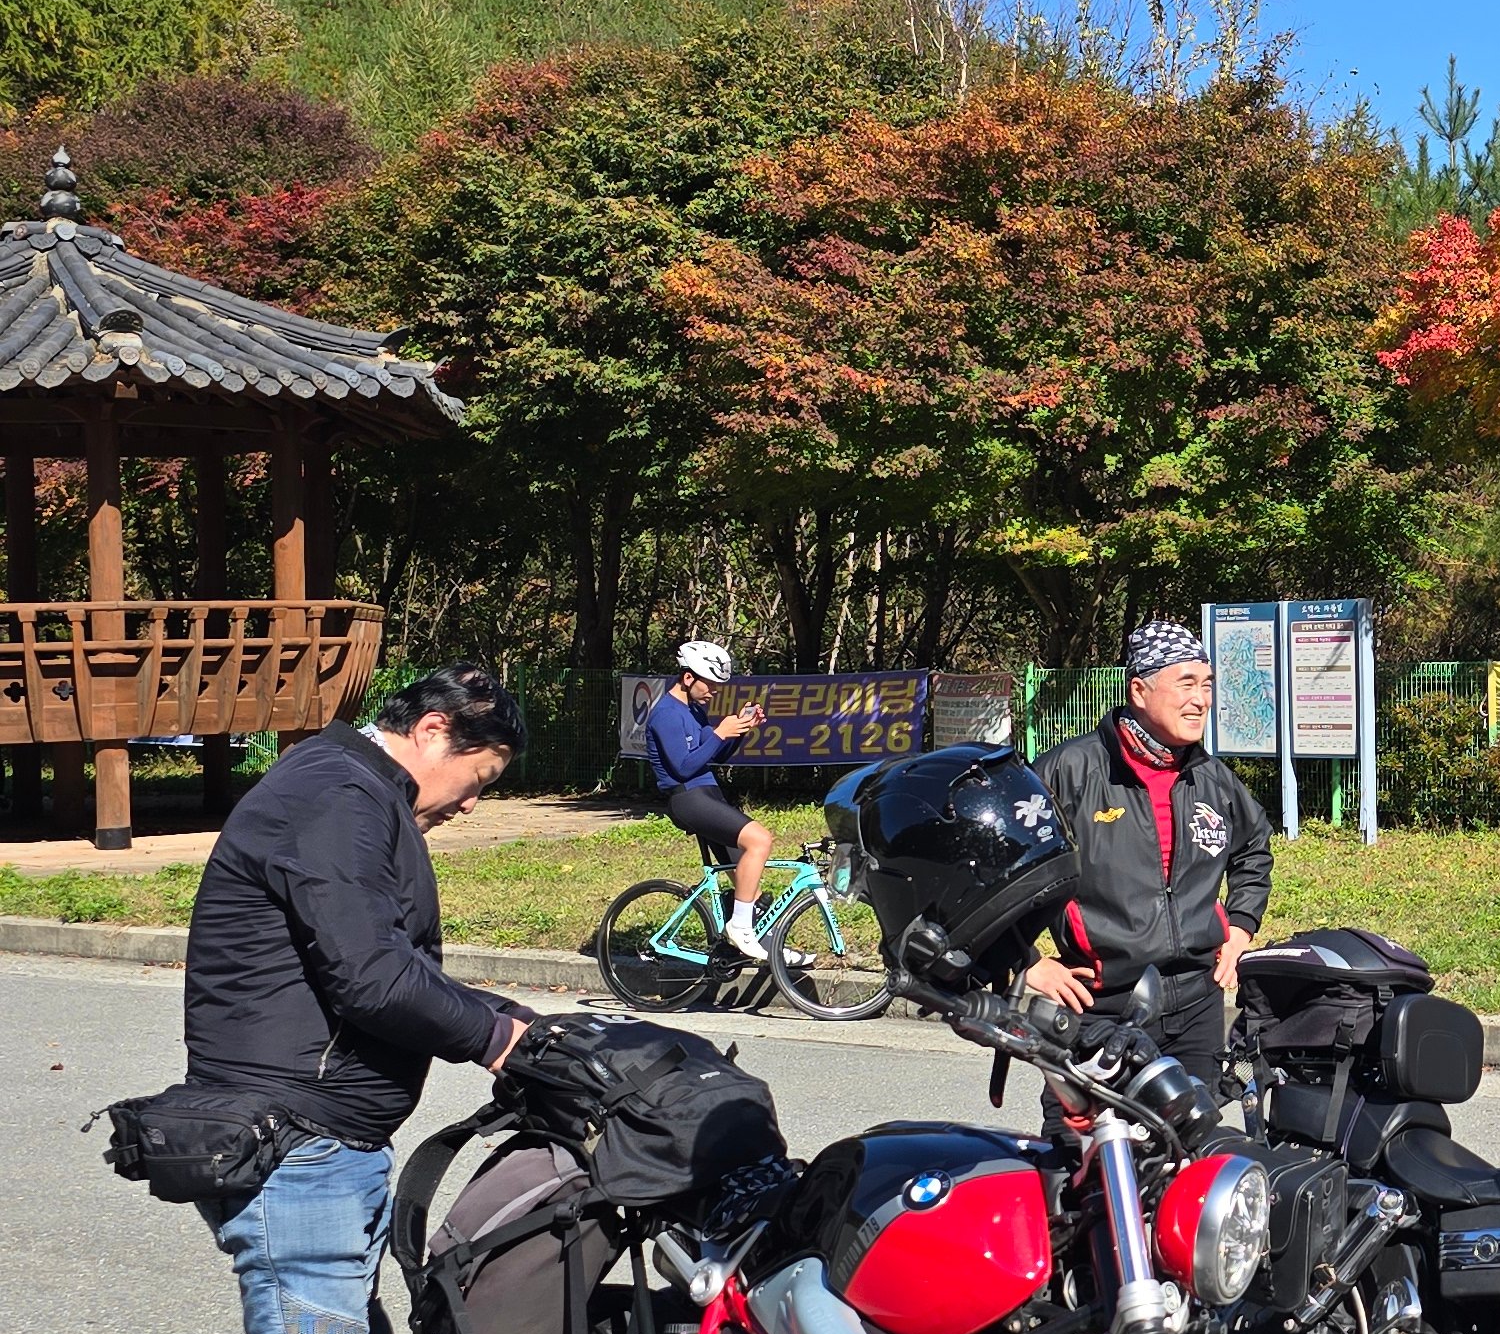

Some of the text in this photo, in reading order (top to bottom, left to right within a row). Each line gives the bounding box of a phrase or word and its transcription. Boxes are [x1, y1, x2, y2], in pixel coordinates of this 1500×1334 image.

[707, 678, 918, 718] 패러글라이딩
[732, 720, 913, 756] 22-2126
[753, 885, 795, 938] ianchi
[860, 1216, 881, 1244] 719
